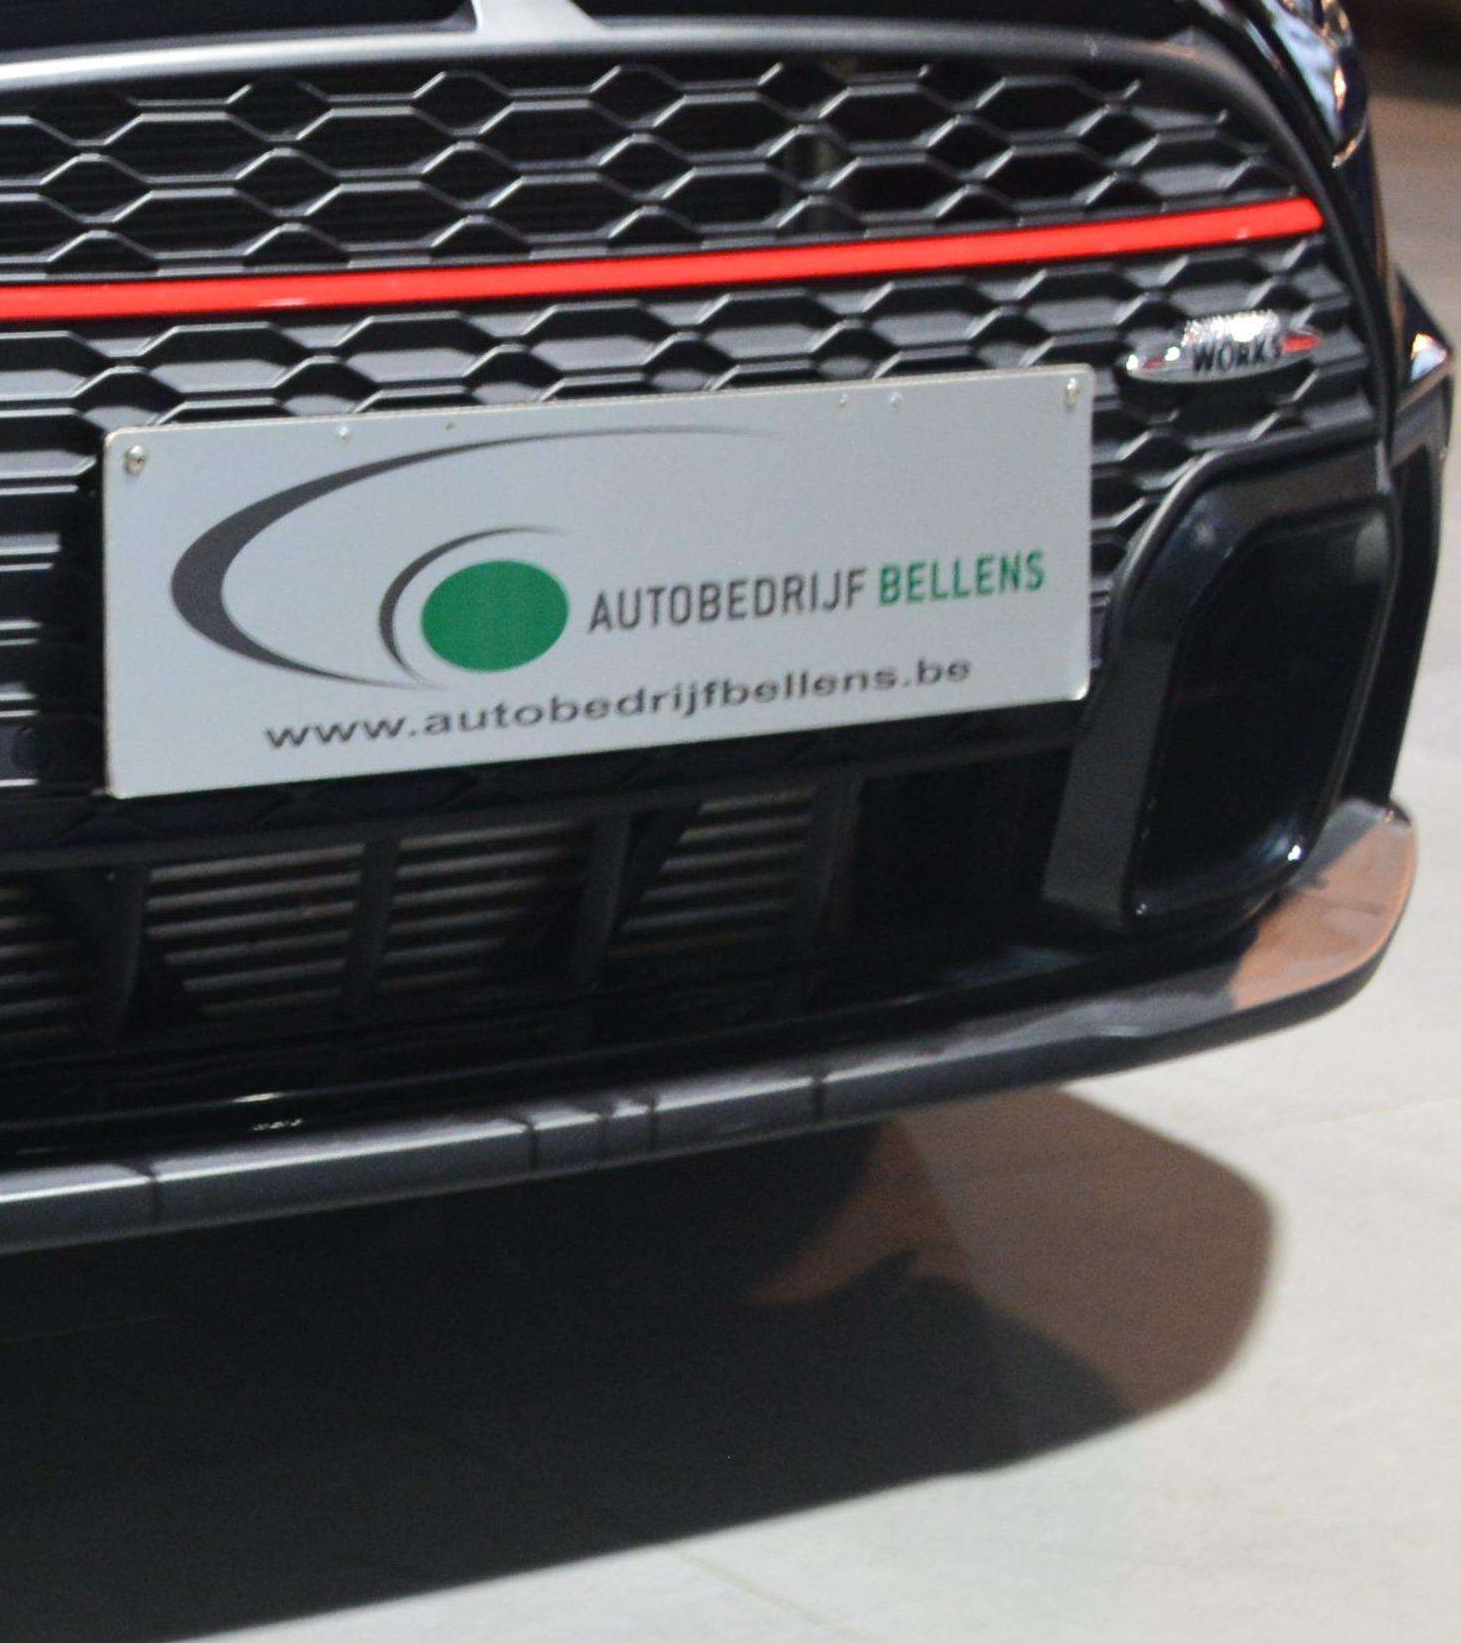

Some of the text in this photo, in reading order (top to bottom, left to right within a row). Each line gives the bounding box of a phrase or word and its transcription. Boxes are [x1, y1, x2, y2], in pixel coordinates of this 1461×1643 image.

[588, 548, 1046, 635] AUTOBEDRIJF BELLENS
[264, 655, 972, 749] www.autobedrijfbellens.be
